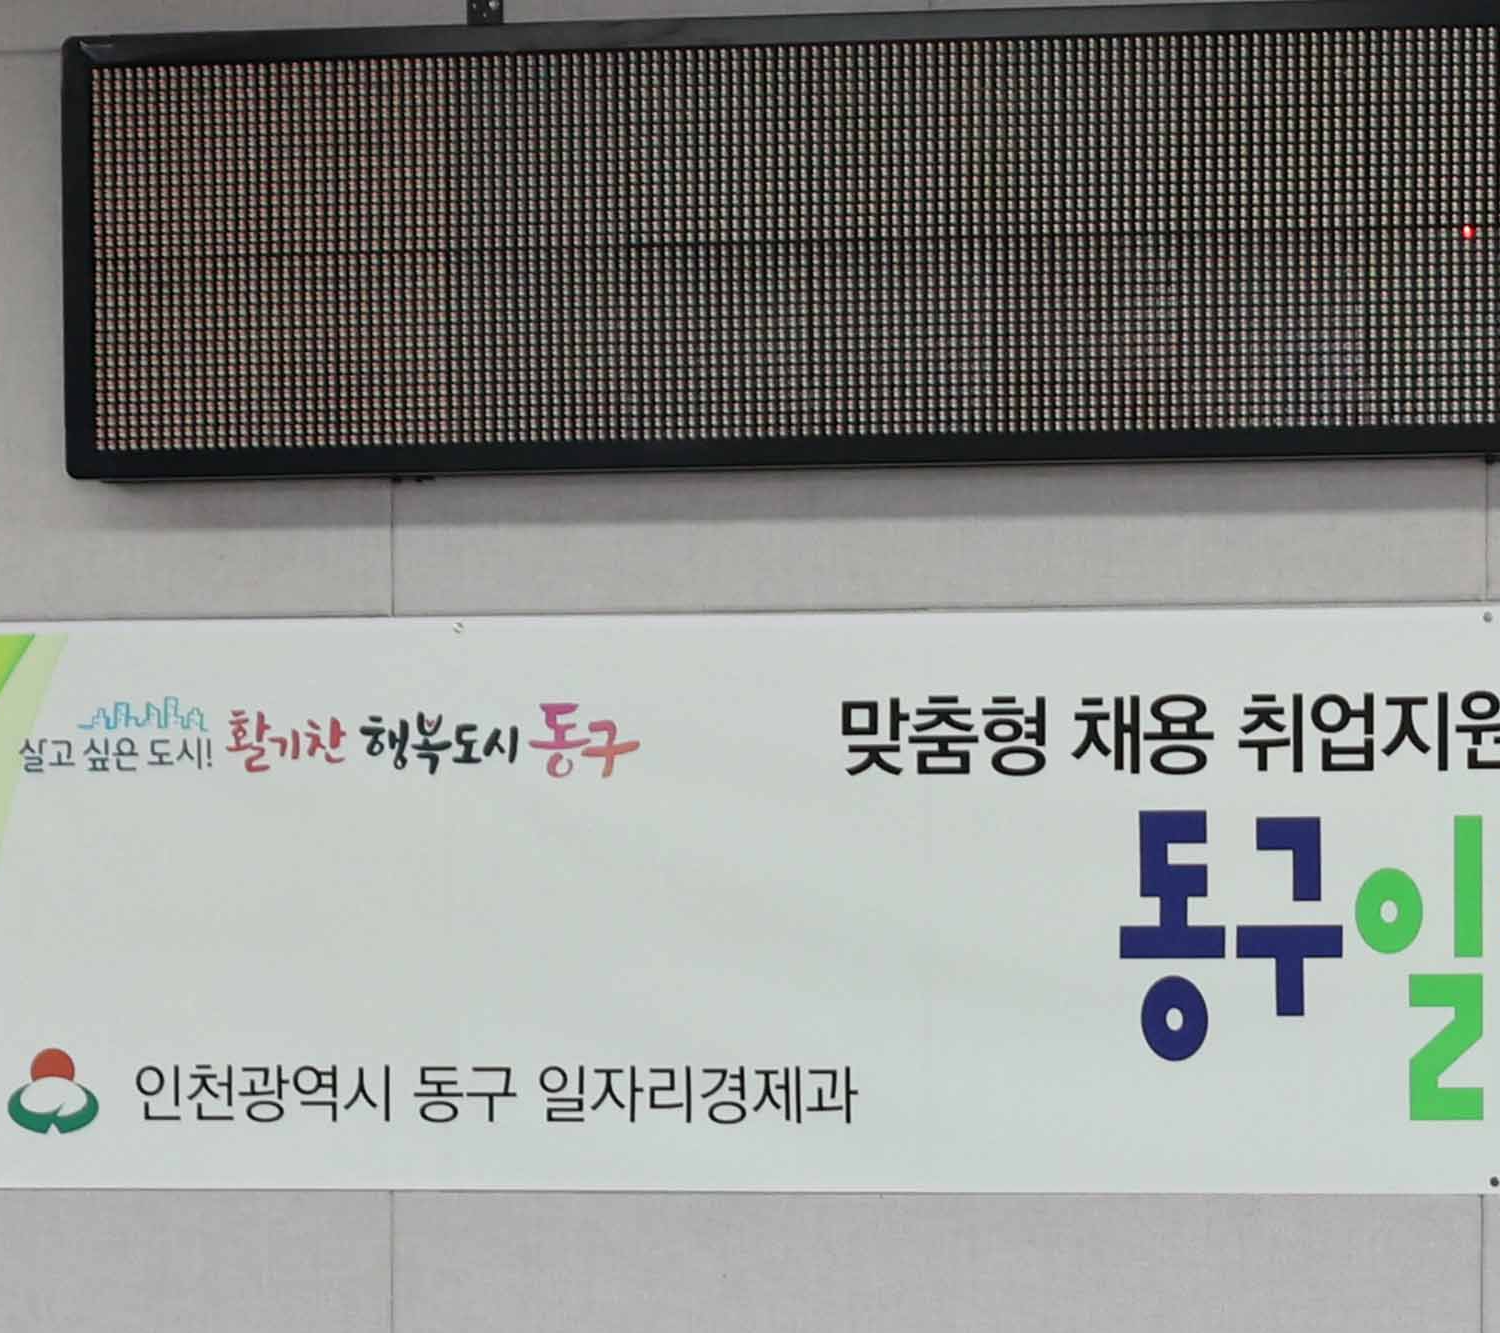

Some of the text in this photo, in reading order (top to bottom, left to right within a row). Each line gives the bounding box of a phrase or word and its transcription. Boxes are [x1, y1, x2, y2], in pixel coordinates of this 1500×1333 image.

[17, 737, 212, 774] 살고 싶은 도시!
[225, 702, 641, 779] 활기찬 행복도시 동구
[840, 695, 1047, 777] 맞춤형
[1070, 693, 1215, 776] 채용
[135, 1063, 860, 1125] 인천광역시 동구 일자리경제과
